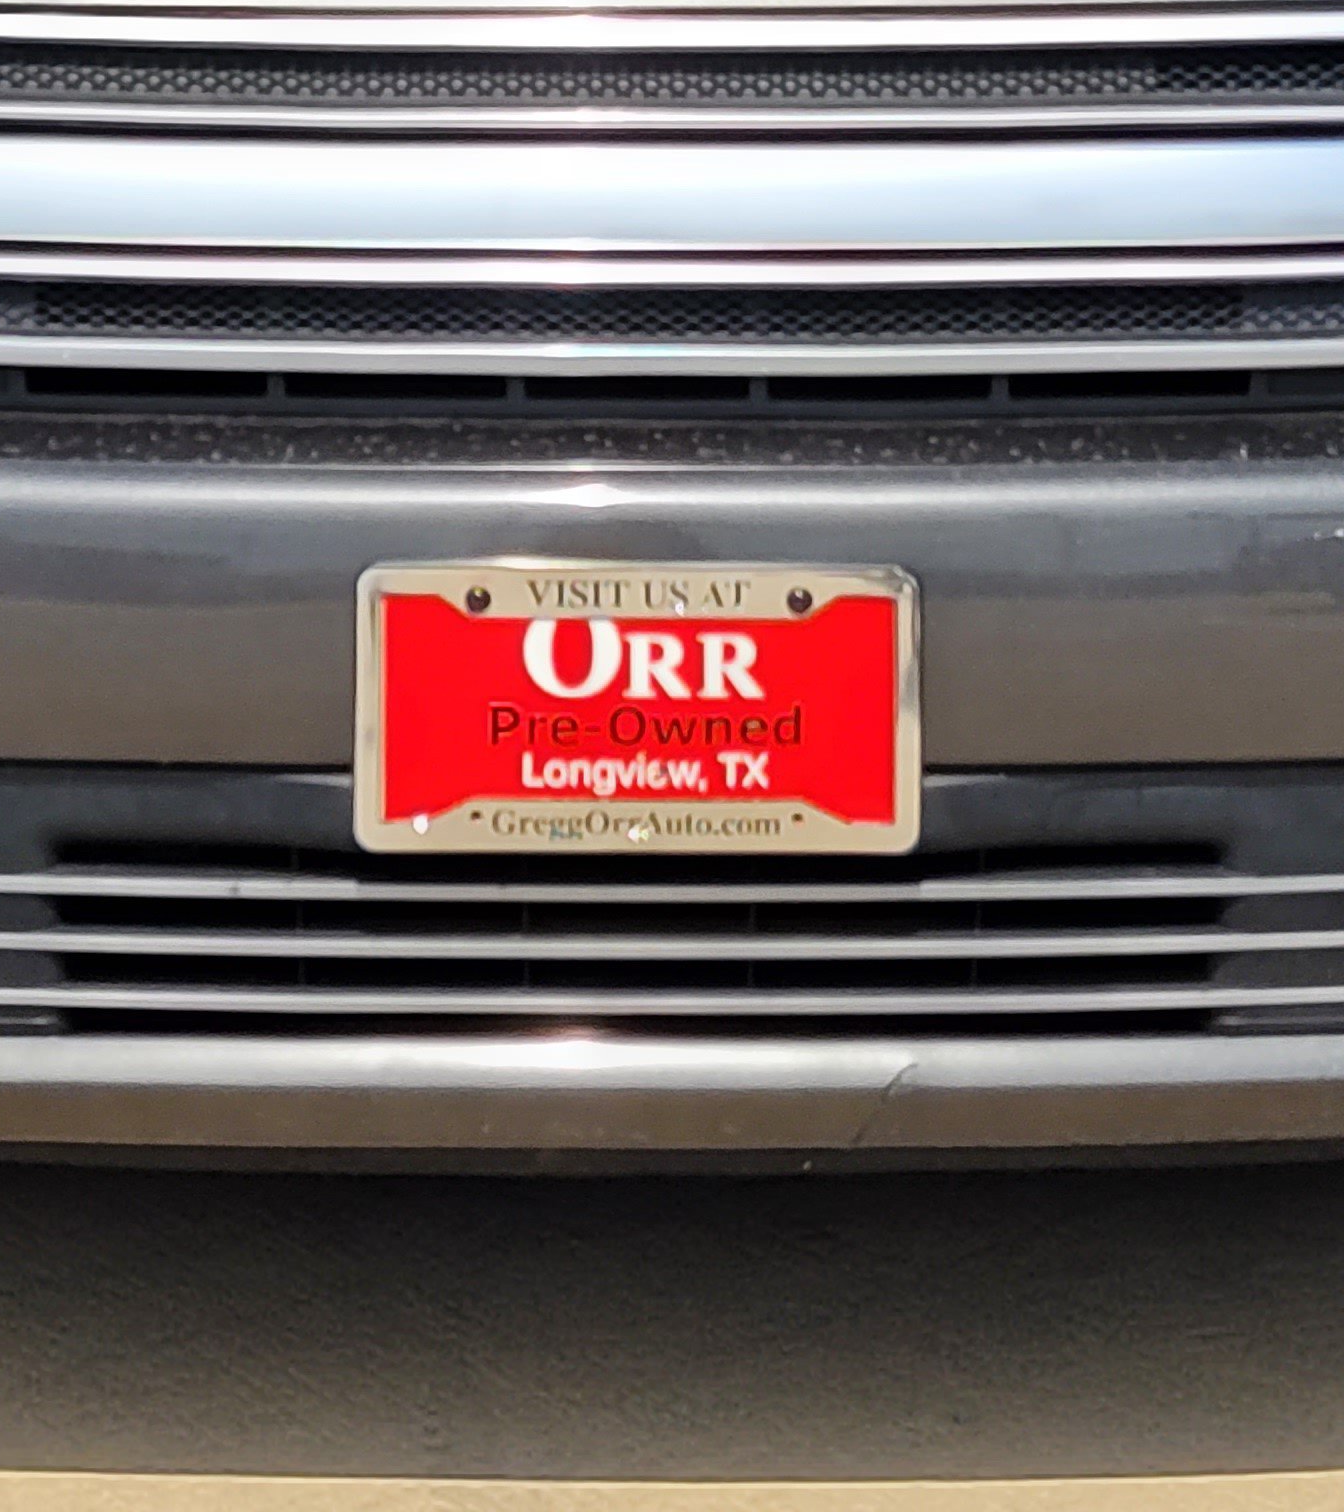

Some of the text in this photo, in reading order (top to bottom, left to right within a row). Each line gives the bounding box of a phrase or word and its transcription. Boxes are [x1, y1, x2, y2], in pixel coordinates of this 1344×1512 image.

[527, 579, 752, 610] VISIT US AT
[523, 618, 764, 699] ORR
[489, 704, 803, 746] Pre-Owned
[521, 751, 769, 797] Longview, TX
[491, 809, 783, 841] GreggOrrAuto.com
